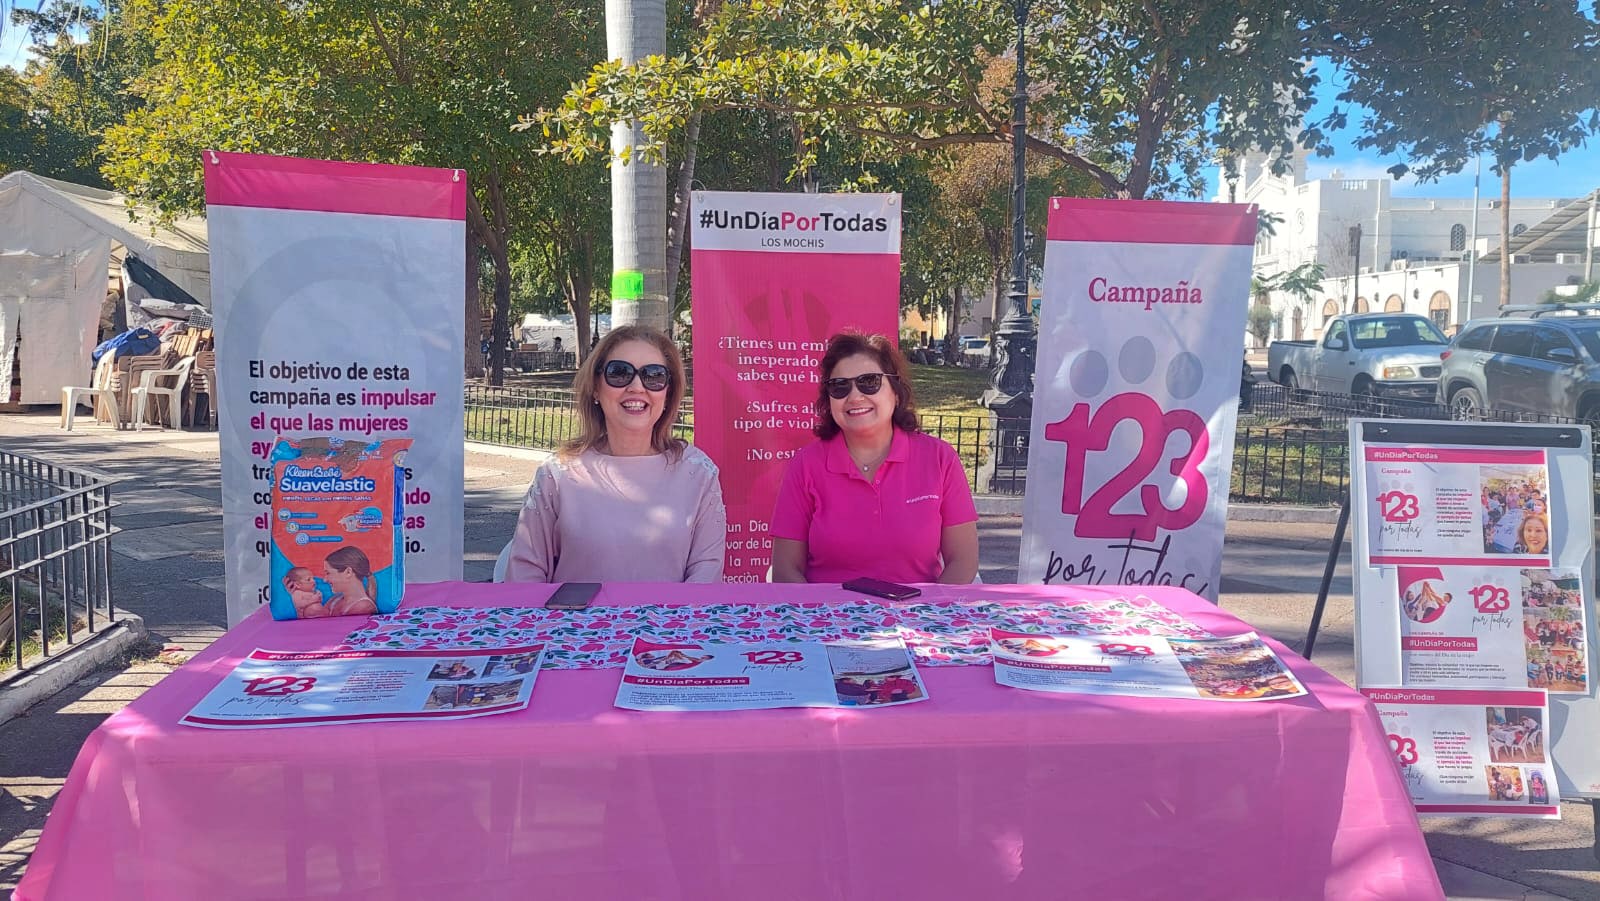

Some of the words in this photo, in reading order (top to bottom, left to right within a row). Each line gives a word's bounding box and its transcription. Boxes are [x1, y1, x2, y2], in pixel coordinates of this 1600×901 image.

[699, 209, 887, 232] #UnDíaPorTodas
[761, 237, 781, 247] LOS
[784, 238, 825, 248] MOCHIS
[1088, 277, 1203, 310] Campaña
[718, 336, 773, 350] ¿Tienes
[778, 341, 797, 351] un
[738, 353, 819, 368] inesperado
[249, 360, 264, 379] El
[269, 361, 342, 384] objetivo
[346, 362, 368, 380] de
[372, 365, 410, 381] esta
[737, 369, 775, 382] sabes
[778, 371, 806, 385] qué
[249, 387, 331, 408] campaña
[336, 393, 356, 406] es
[361, 388, 436, 409] impulsar
[747, 401, 798, 413] ¿Sufres
[250, 412, 265, 430] el
[270, 416, 303, 434] que
[308, 413, 334, 431] las
[339, 414, 409, 435] mujeres
[734, 417, 762, 432] tipo
[766, 416, 784, 428] de
[747, 448, 773, 460] ¡No
[1045, 392, 1209, 542] 123
[281, 478, 374, 491] Suavelastic
[1376, 491, 1419, 522] 123
[254, 512, 269, 529] el
[749, 520, 768, 532] Día
[746, 538, 759, 549] de
[761, 537, 772, 549] la
[729, 556, 741, 567] la
[1468, 585, 1510, 613] 123
[740, 650, 804, 664] 123
[242, 676, 317, 696] 123
